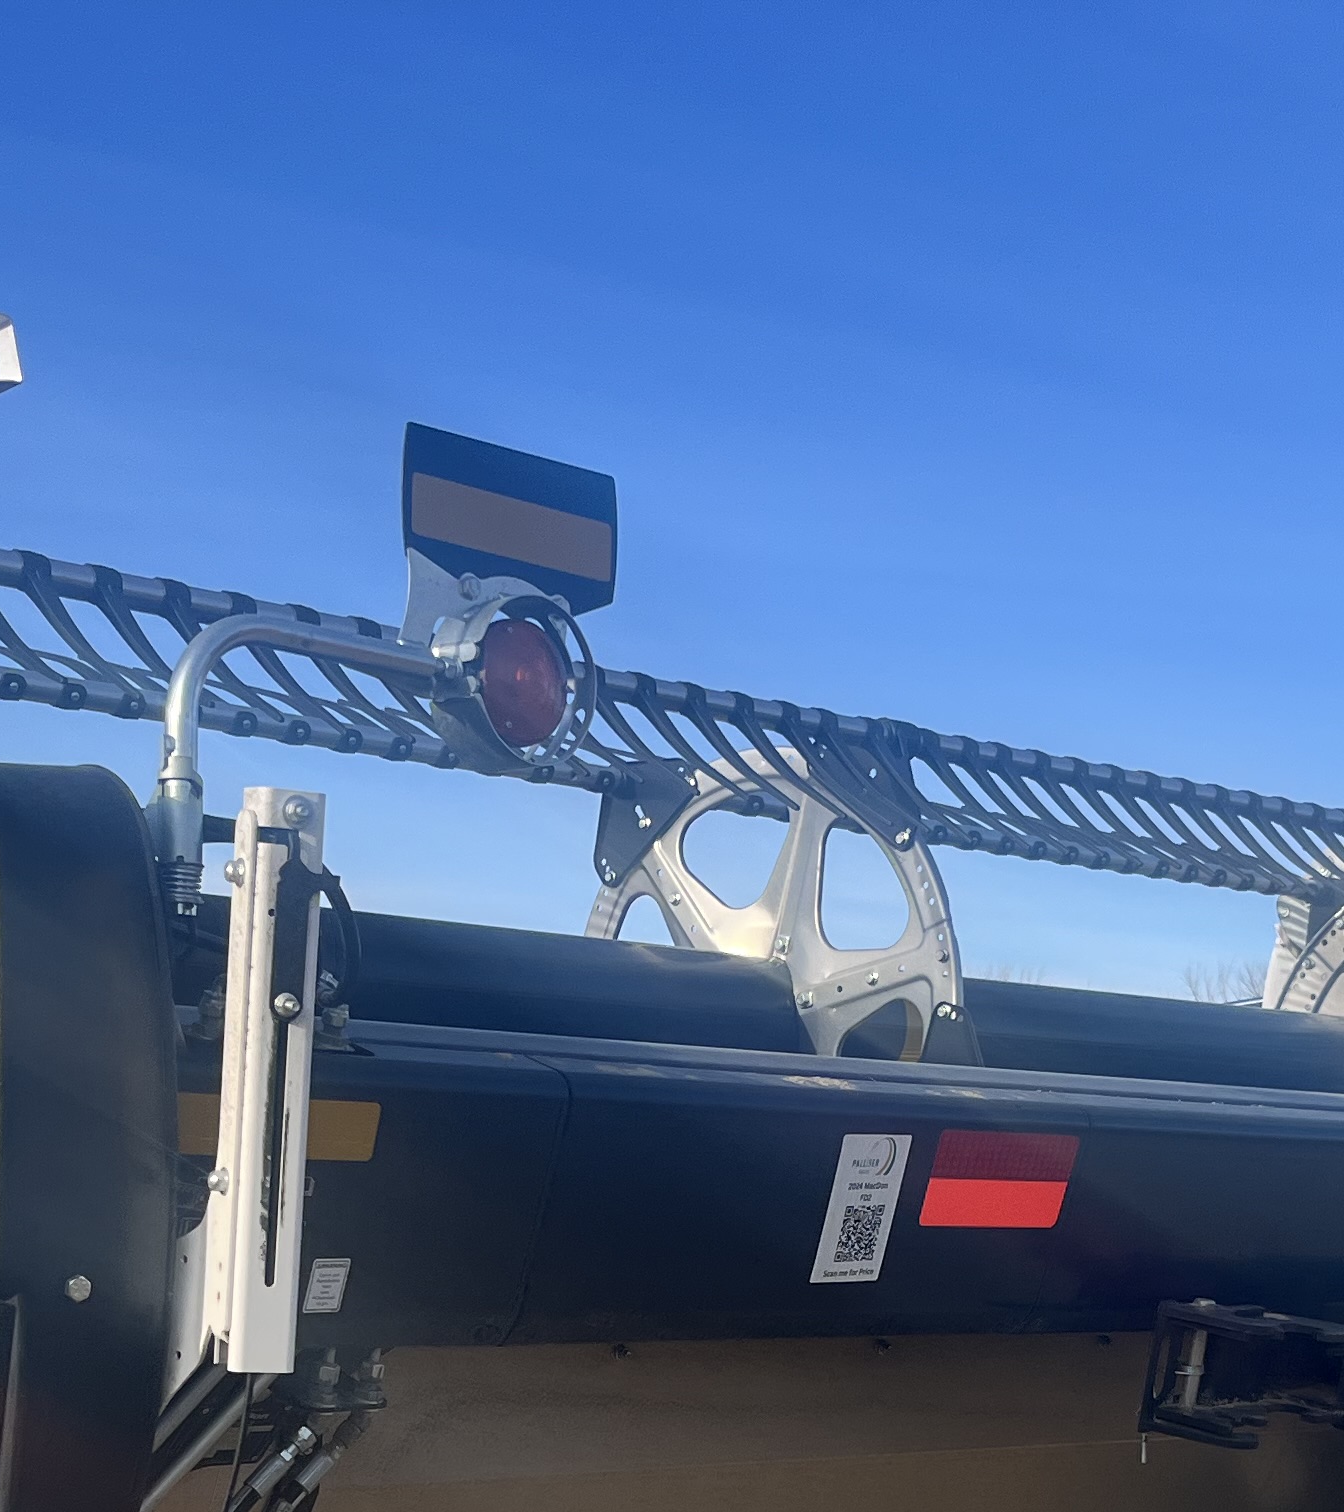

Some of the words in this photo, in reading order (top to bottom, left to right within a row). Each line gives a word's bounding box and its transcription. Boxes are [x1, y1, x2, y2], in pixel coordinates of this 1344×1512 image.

[823, 1269, 837, 1278] Scan
[849, 1268, 858, 1277] for
[858, 1268, 875, 1276] Price
